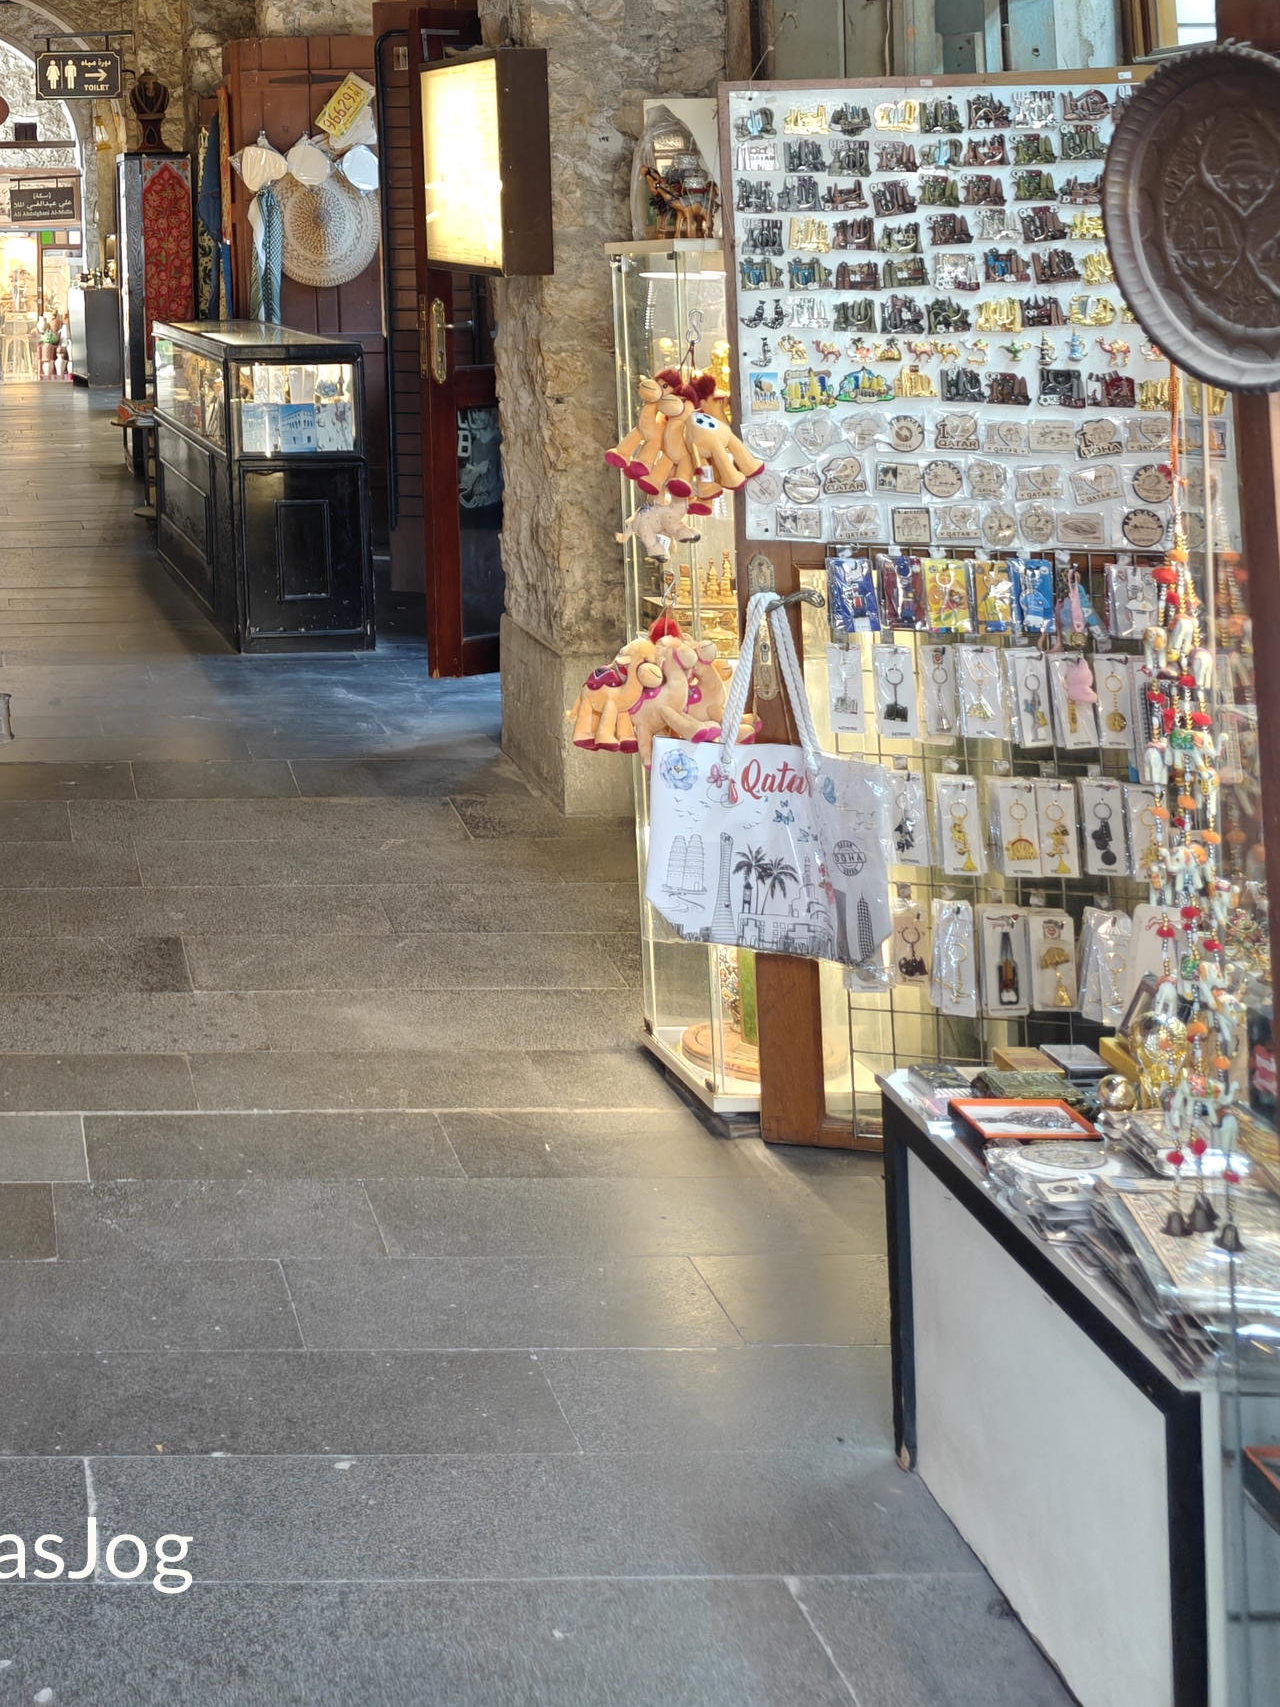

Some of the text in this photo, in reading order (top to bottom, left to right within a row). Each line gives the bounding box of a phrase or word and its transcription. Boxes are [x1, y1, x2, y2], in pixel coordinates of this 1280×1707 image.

[81, 58, 111, 68] دورة مياه
[84, 84, 110, 92] TOILET
[324, 92, 356, 131] 96629
[937, 440, 978, 449] QATAR
[1083, 445, 1121, 456] DOHA
[826, 482, 864, 492] QATAR
[1086, 493, 1111, 502] QATAR
